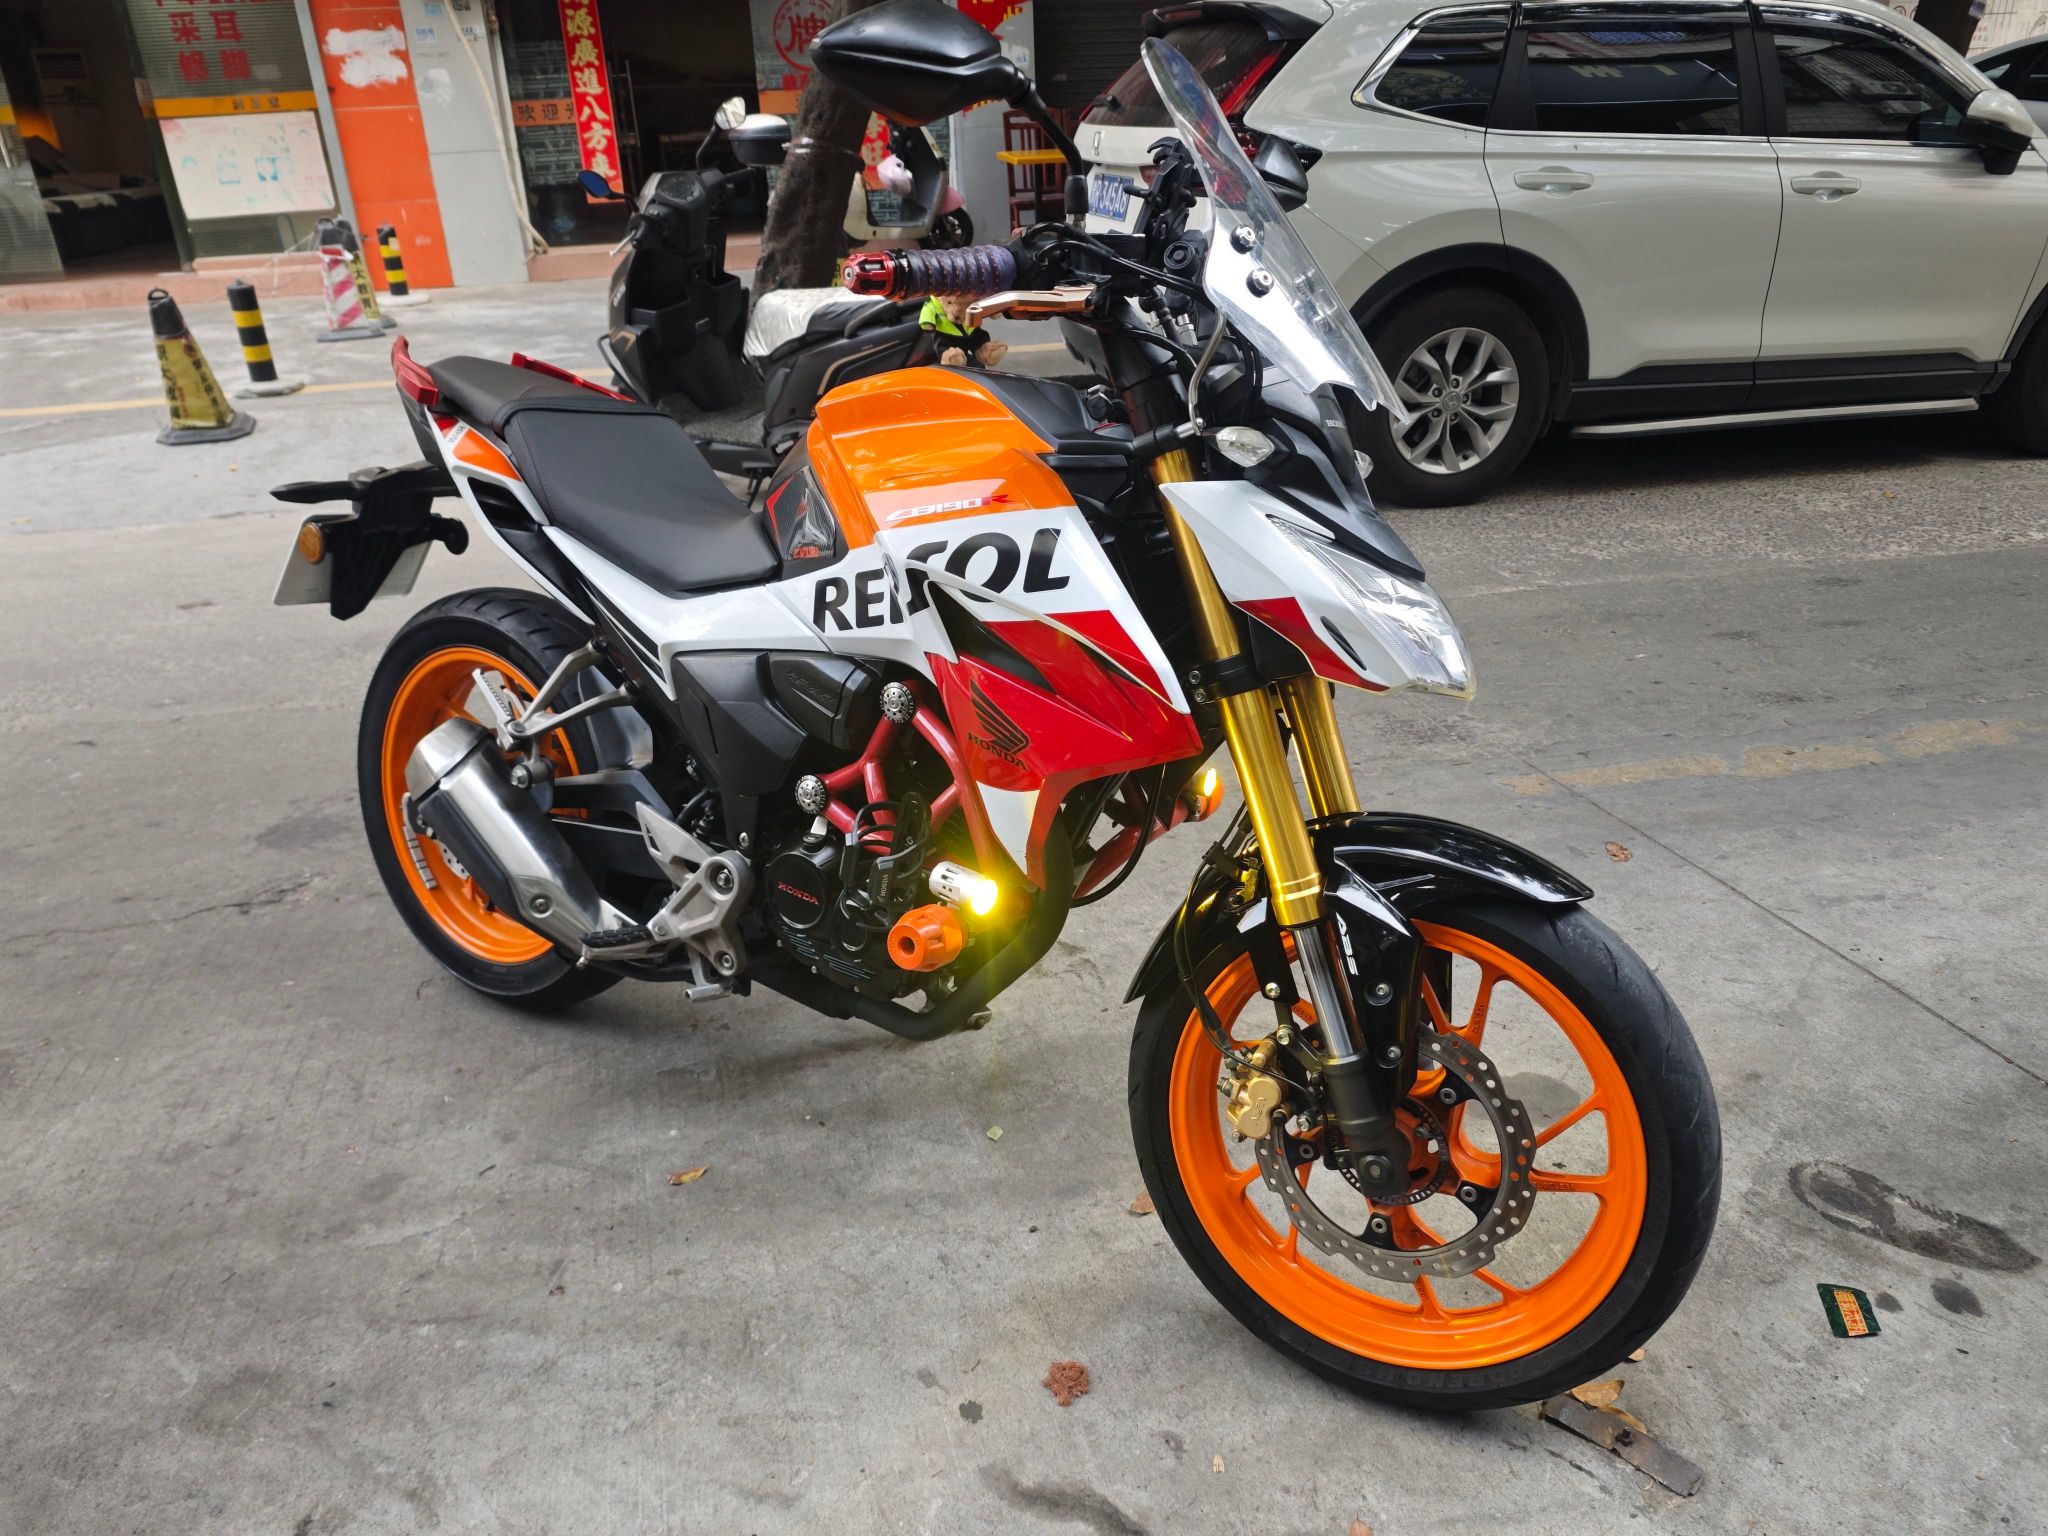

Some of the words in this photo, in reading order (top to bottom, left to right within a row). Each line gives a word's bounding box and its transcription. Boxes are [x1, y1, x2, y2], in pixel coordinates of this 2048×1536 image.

[967, 731, 1029, 772] HONDA
[777, 881, 819, 906] HONDA
[880, 874, 889, 897] HONDA
[1335, 912, 1359, 976] ABS
